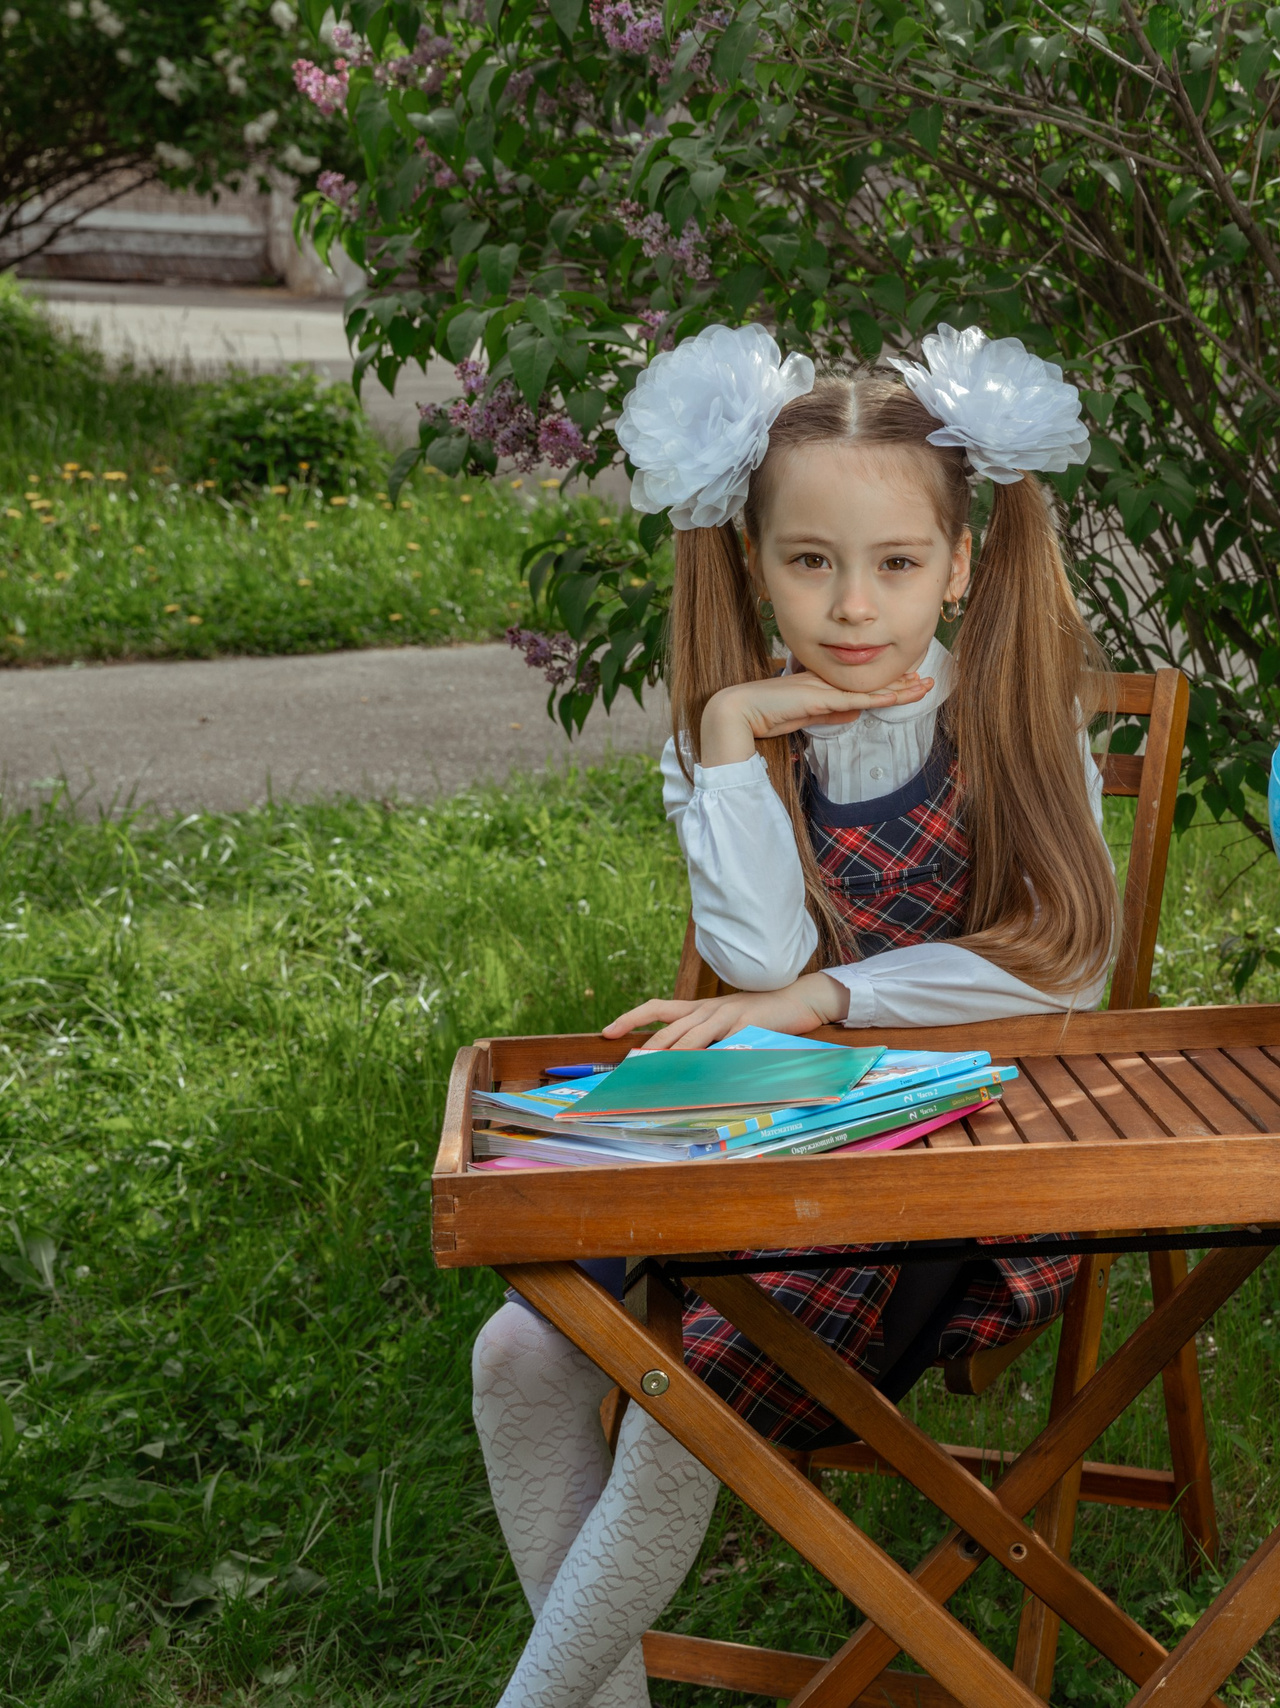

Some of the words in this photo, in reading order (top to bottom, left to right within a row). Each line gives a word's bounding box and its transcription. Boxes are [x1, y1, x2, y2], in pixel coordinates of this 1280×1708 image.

[917, 1091, 933, 1100] Часть
[920, 1108, 933, 1117] Часть
[760, 1122, 803, 1138] Математика
[791, 1136, 835, 1155] Окружающий
[834, 1132, 848, 1144] мир
